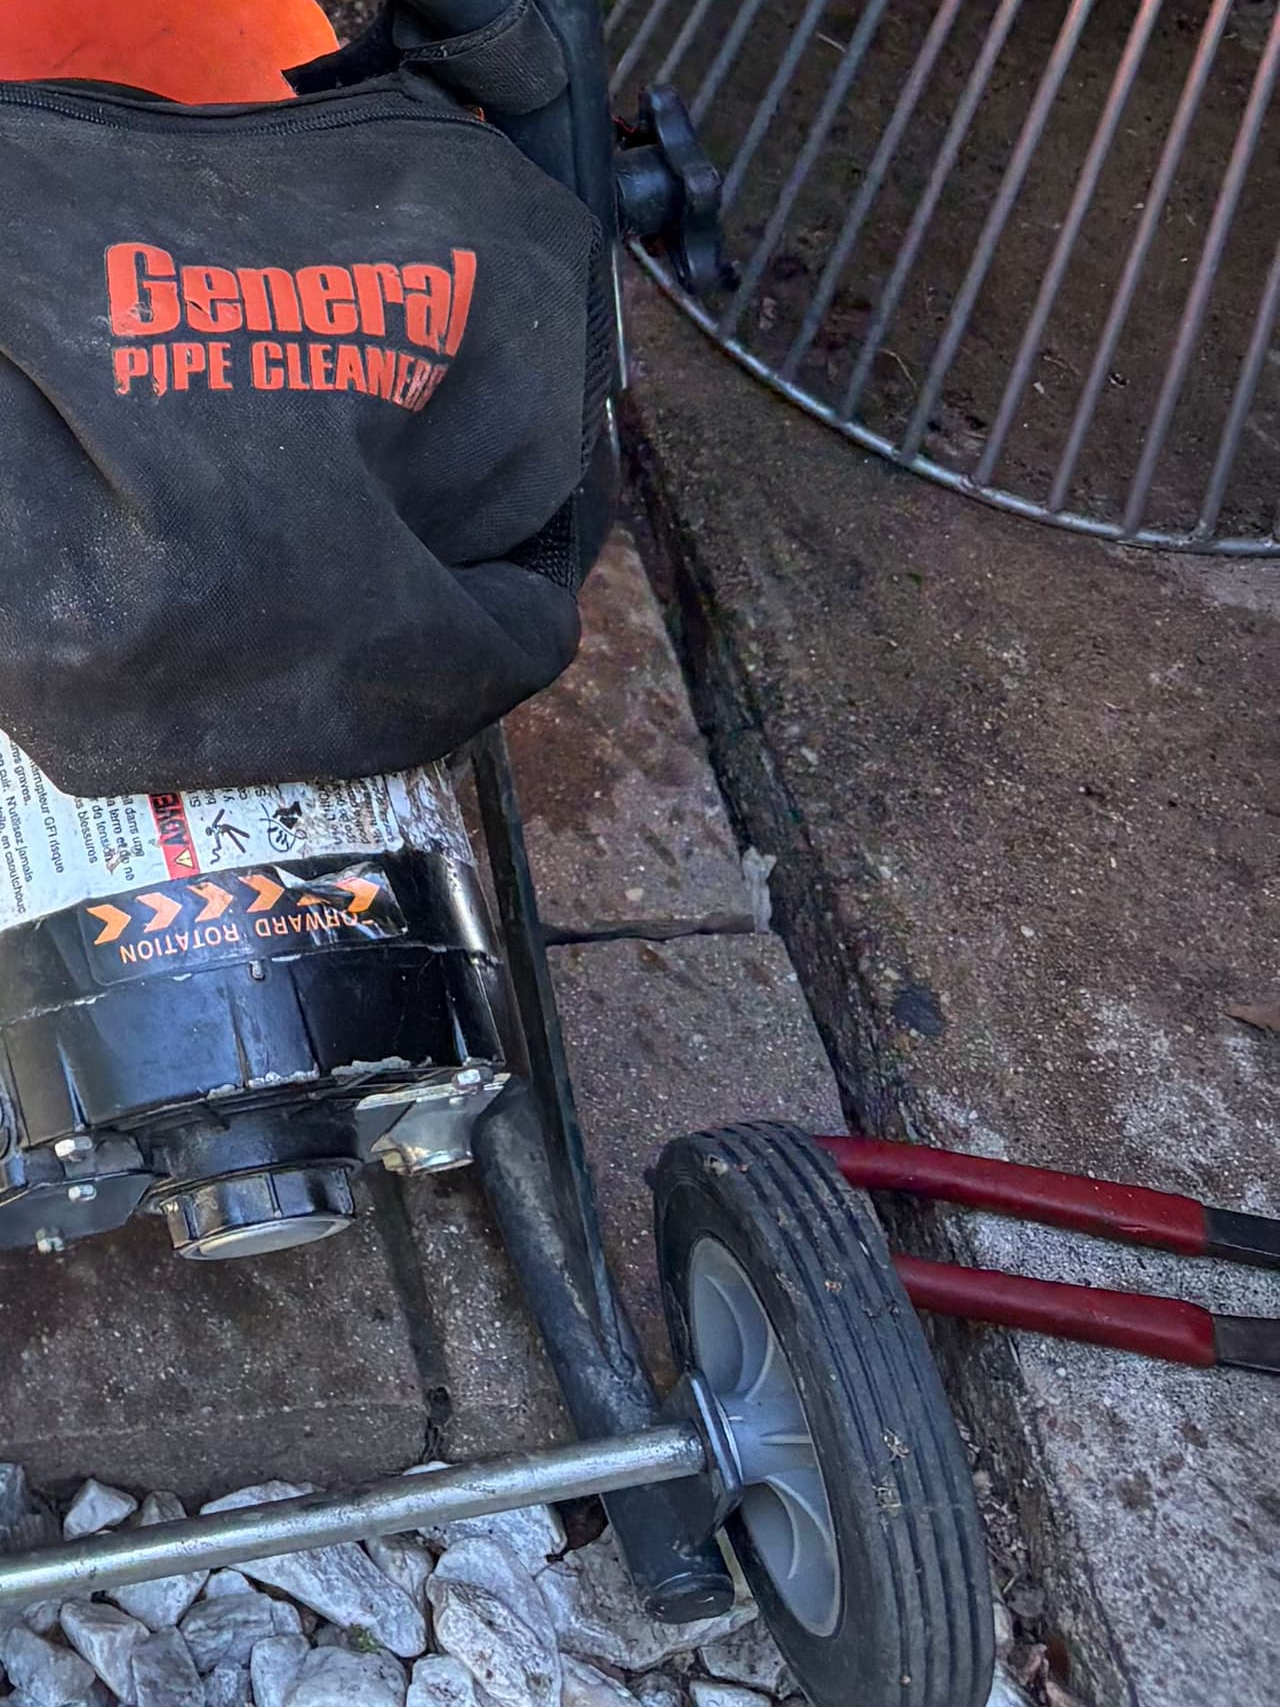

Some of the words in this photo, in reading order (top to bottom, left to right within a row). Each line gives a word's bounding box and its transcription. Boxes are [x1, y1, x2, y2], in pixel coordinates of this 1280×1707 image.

[105, 242, 477, 357] General
[114, 342, 233, 398] PIPE
[77, 810, 98, 864] blessures
[124, 806, 139, 834] dans
[15, 845, 35, 883] jamais
[119, 922, 240, 963] ROTATION
